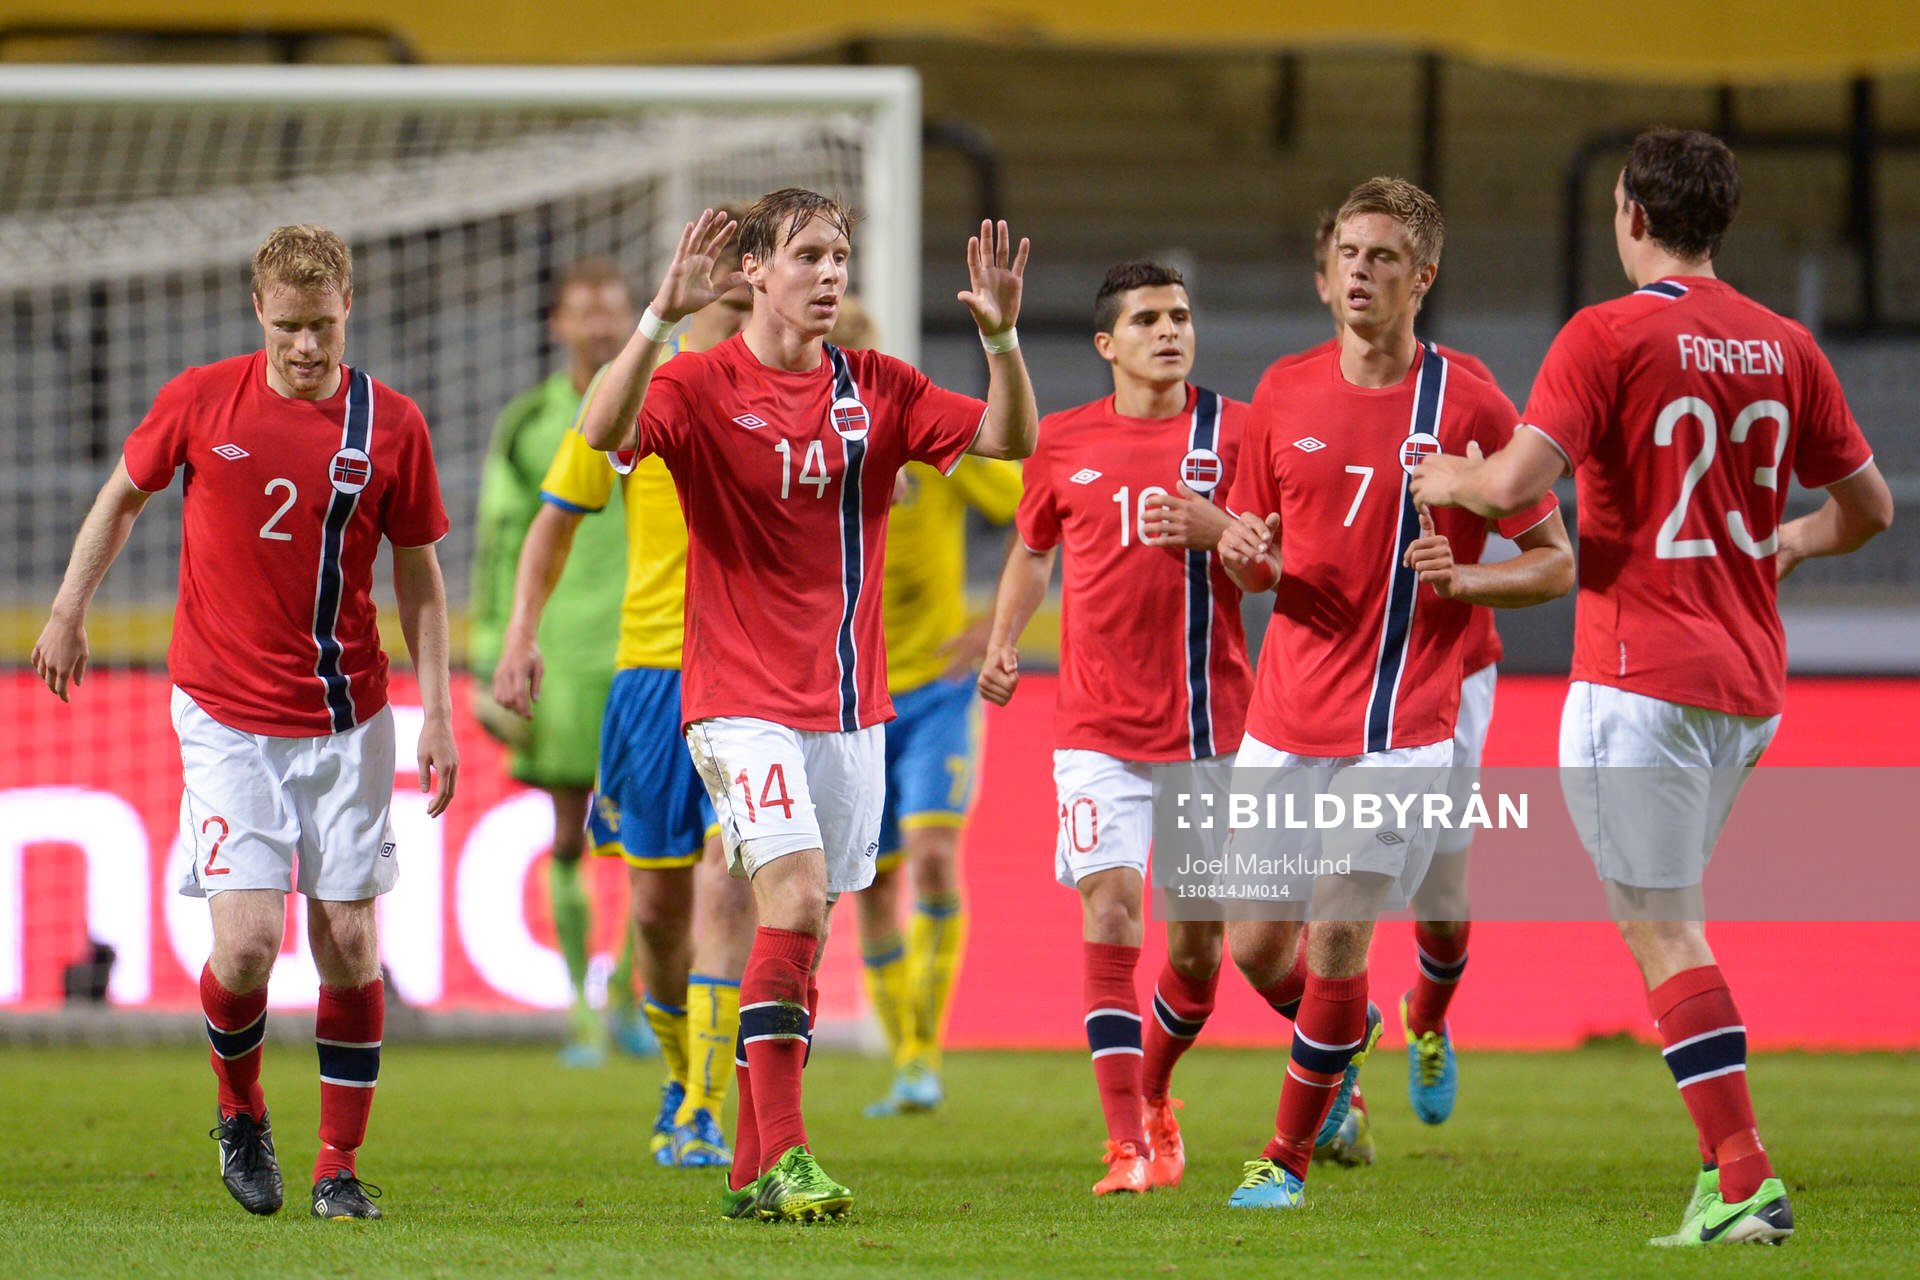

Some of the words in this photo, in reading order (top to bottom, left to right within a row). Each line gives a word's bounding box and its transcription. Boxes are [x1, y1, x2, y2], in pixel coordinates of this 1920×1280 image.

[1677, 334, 1784, 376] FORREN
[774, 438, 832, 500] 14
[1344, 465, 1374, 527] 7
[1654, 396, 1790, 560] 23
[259, 478, 298, 541] 2
[1112, 486, 1170, 547] 10
[734, 763, 795, 822] 14
[201, 815, 231, 876] 2
